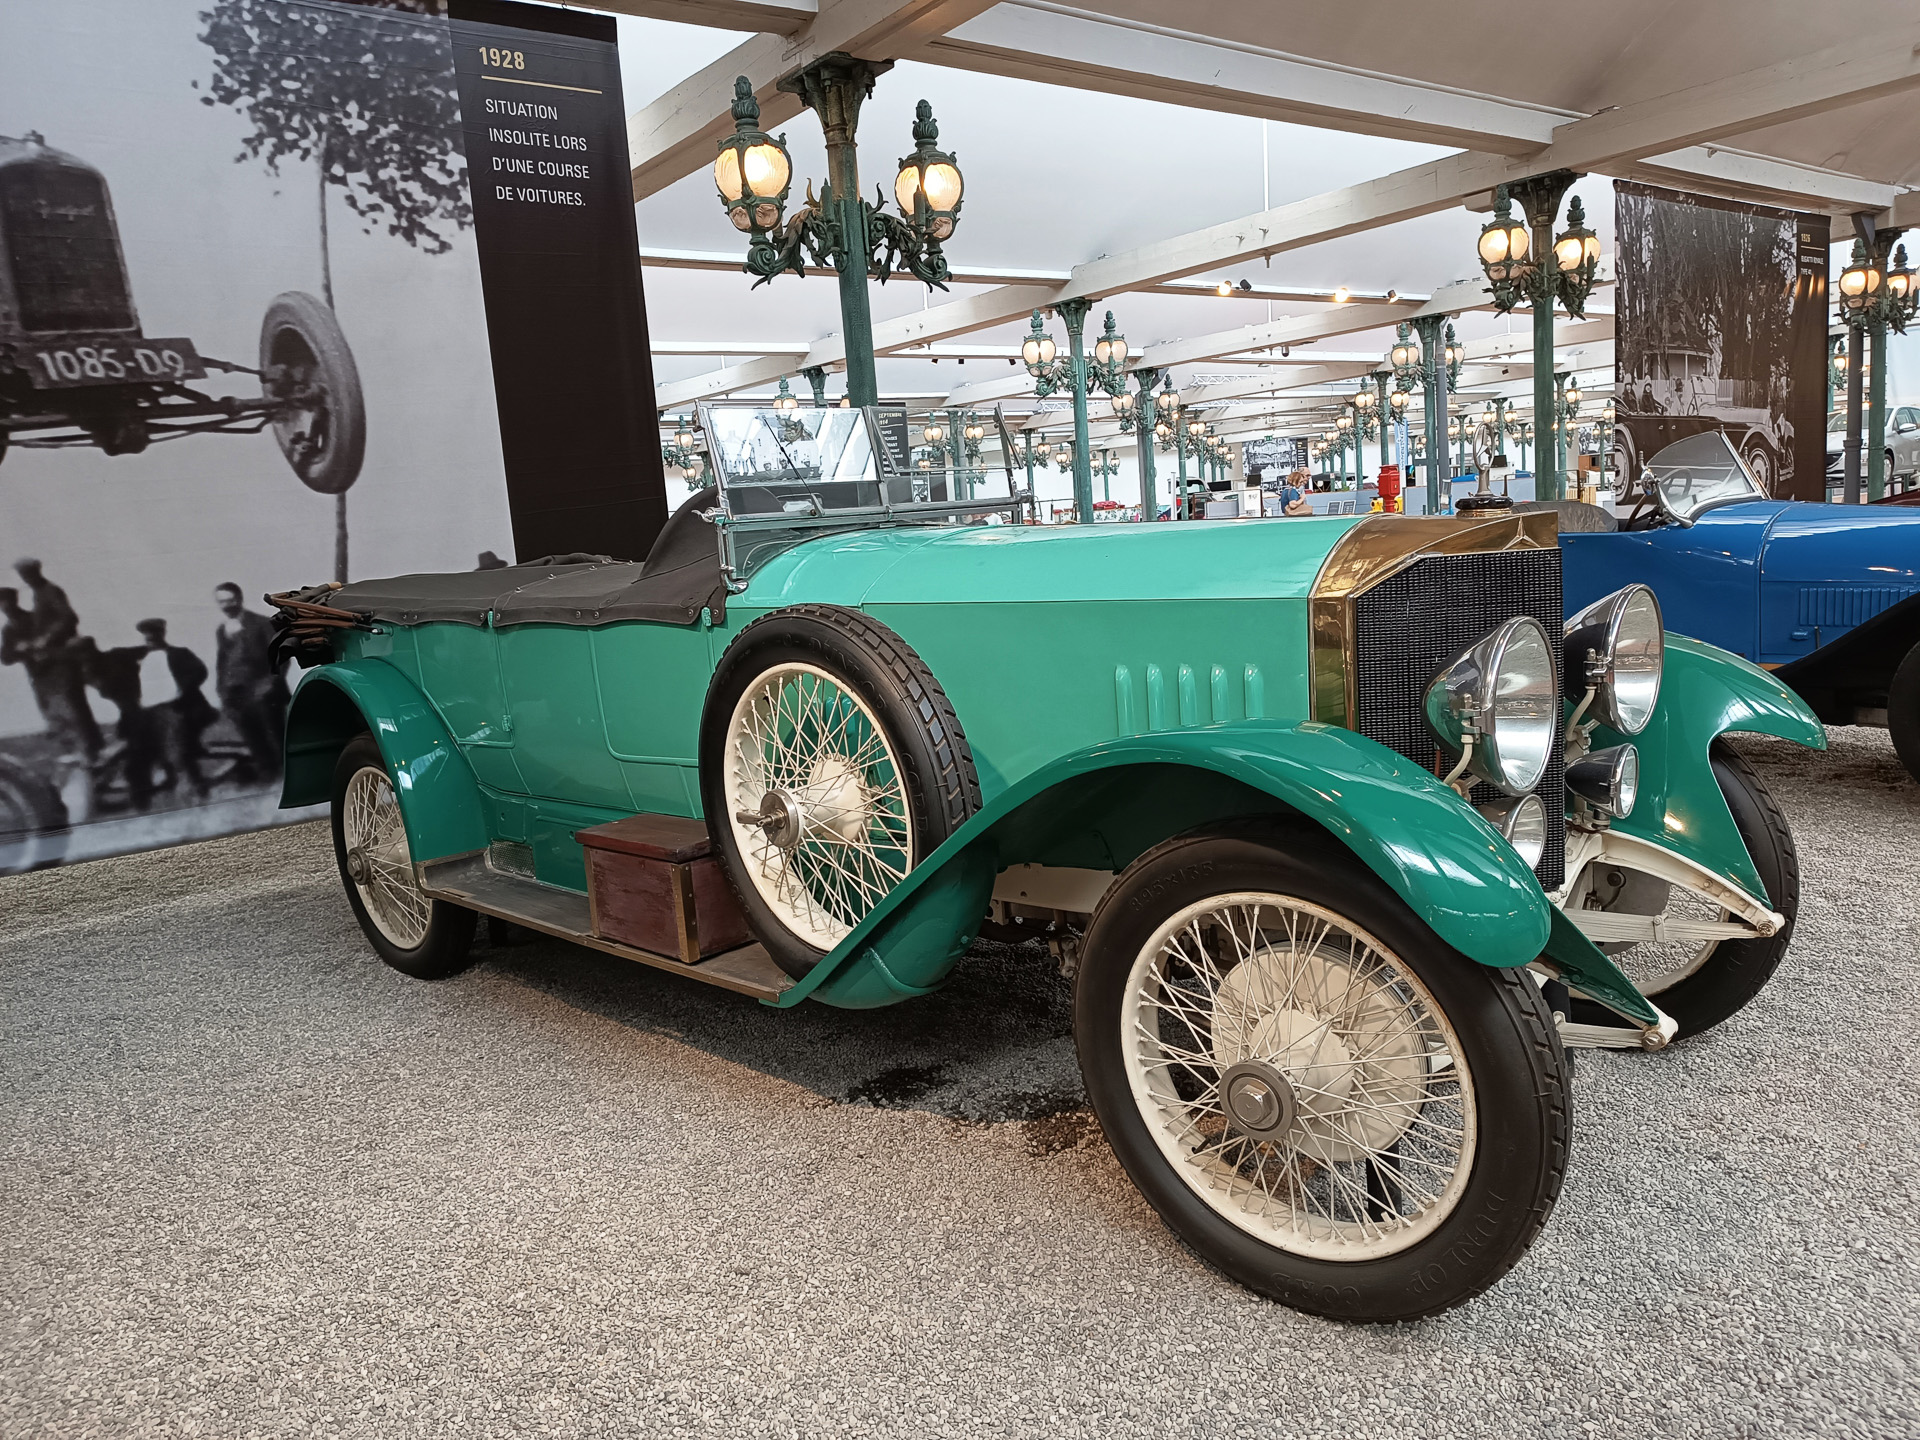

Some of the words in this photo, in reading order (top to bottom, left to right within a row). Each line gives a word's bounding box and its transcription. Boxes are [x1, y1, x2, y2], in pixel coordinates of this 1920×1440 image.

[479, 46, 525, 70] 1928
[485, 98, 558, 120] SITUATION
[489, 127, 551, 147] INSOLITE
[553, 134, 588, 151] LORS
[492, 156, 535, 174] D'UNE
[538, 161, 590, 179] COURSE
[495, 185, 514, 201] DE
[516, 187, 587, 207] VOITURES.
